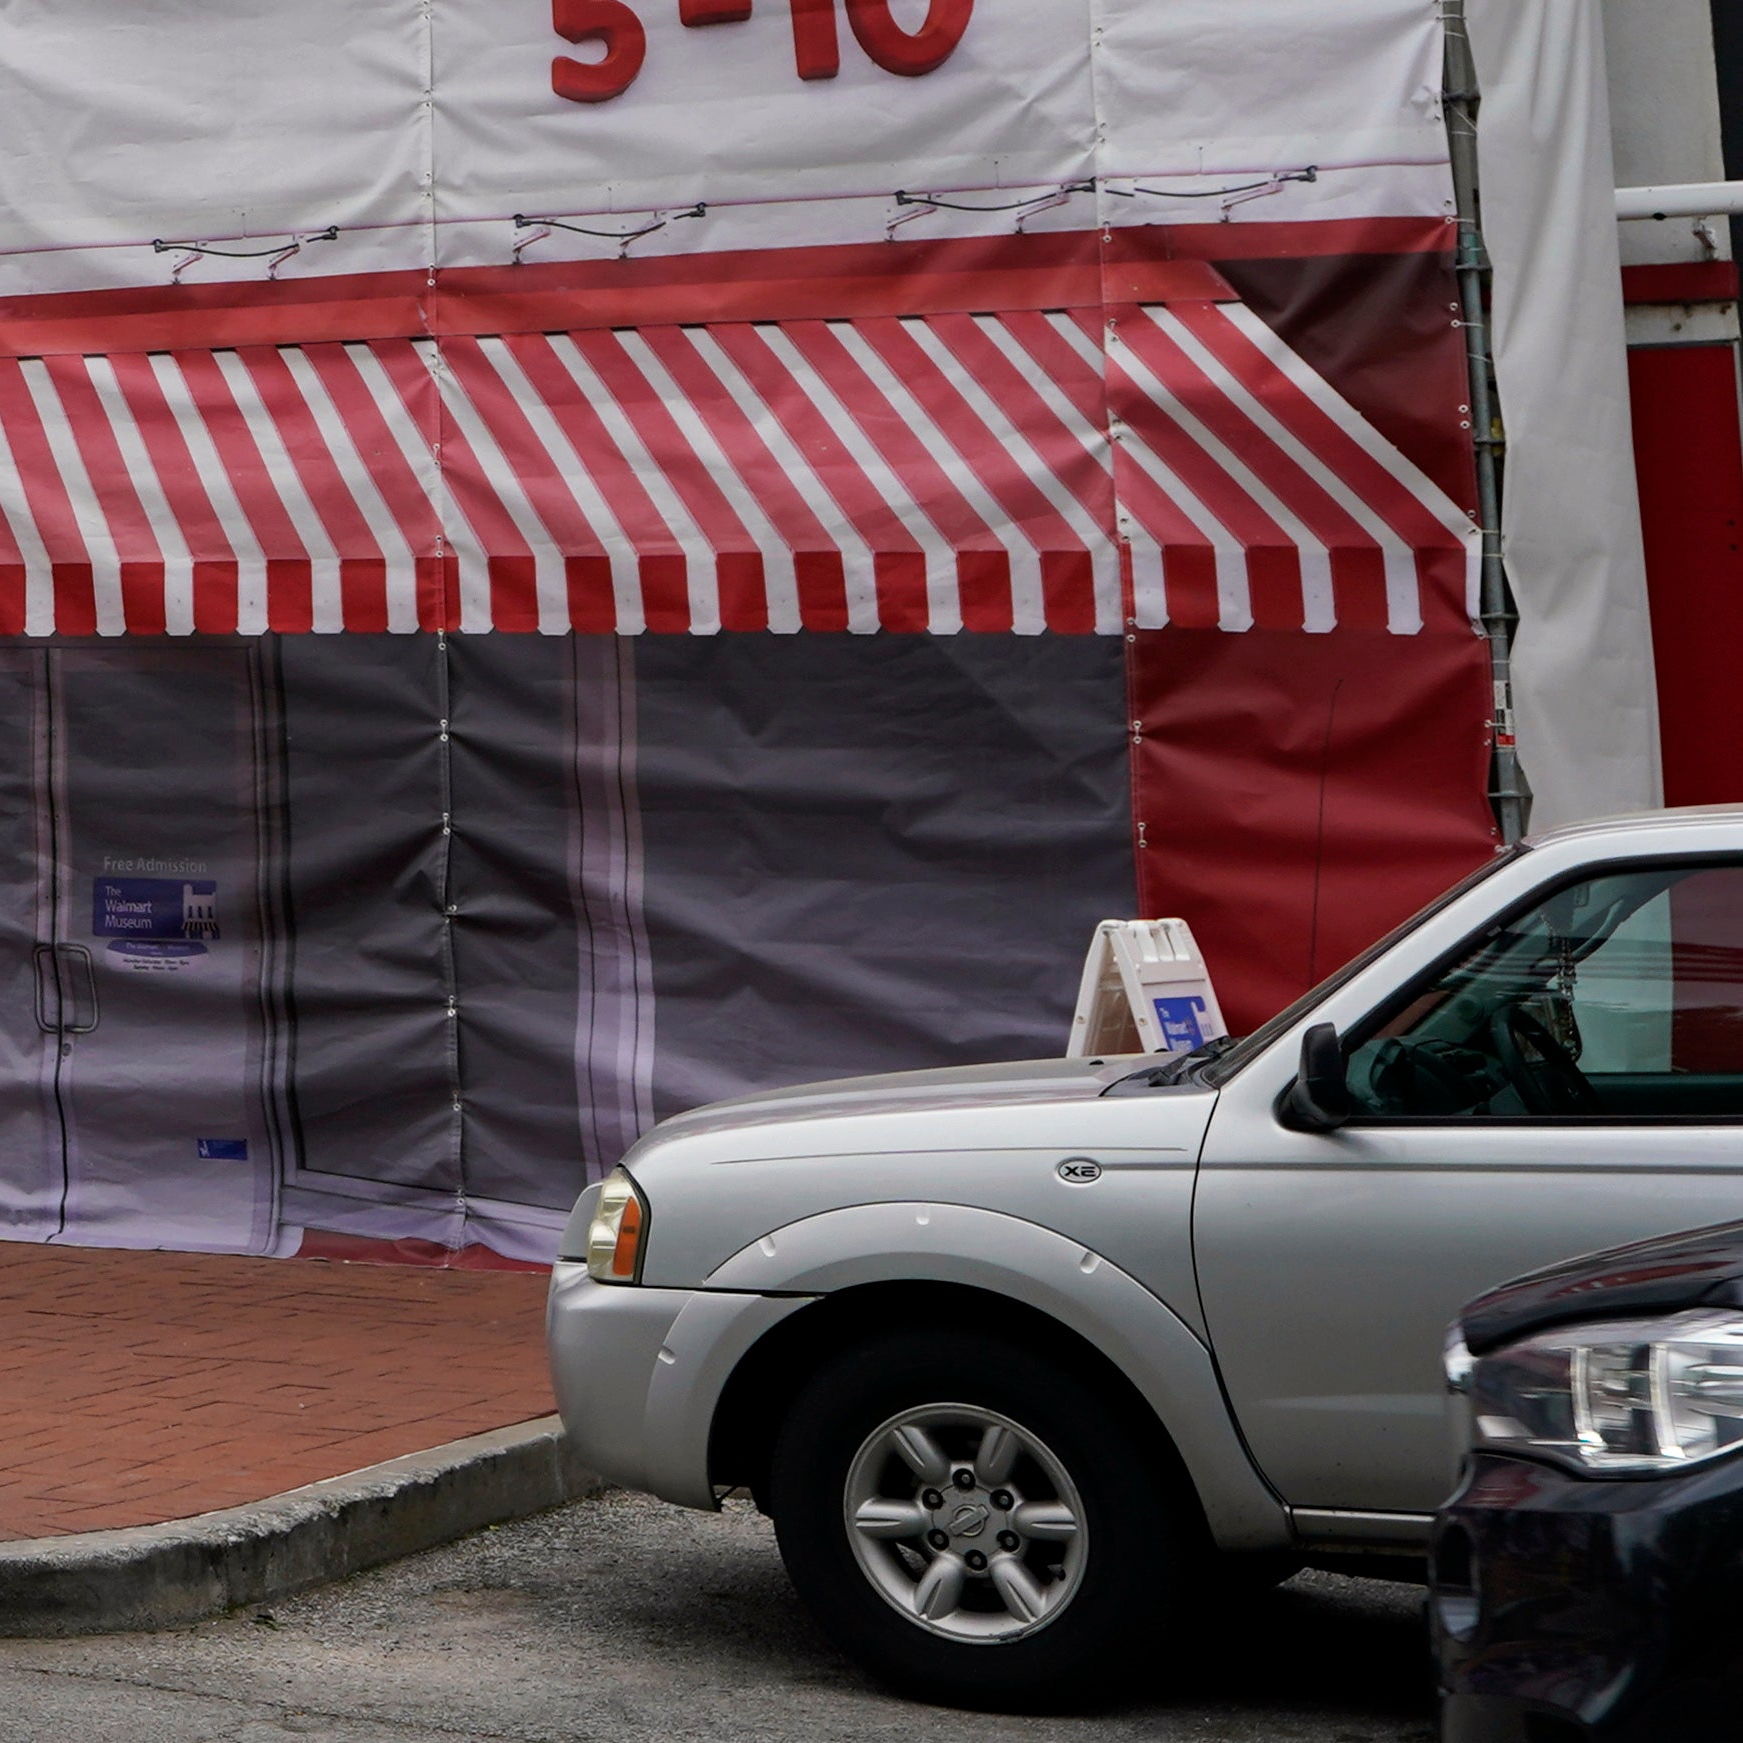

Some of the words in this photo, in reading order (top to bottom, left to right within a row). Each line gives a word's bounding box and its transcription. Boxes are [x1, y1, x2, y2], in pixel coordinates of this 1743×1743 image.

[103, 856, 134, 871] Free
[136, 858, 207, 873] Admission
[105, 885, 122, 896] The
[105, 899, 153, 914] Walmart
[105, 914, 153, 929] Museum
[1064, 1166, 1097, 1177] XE
